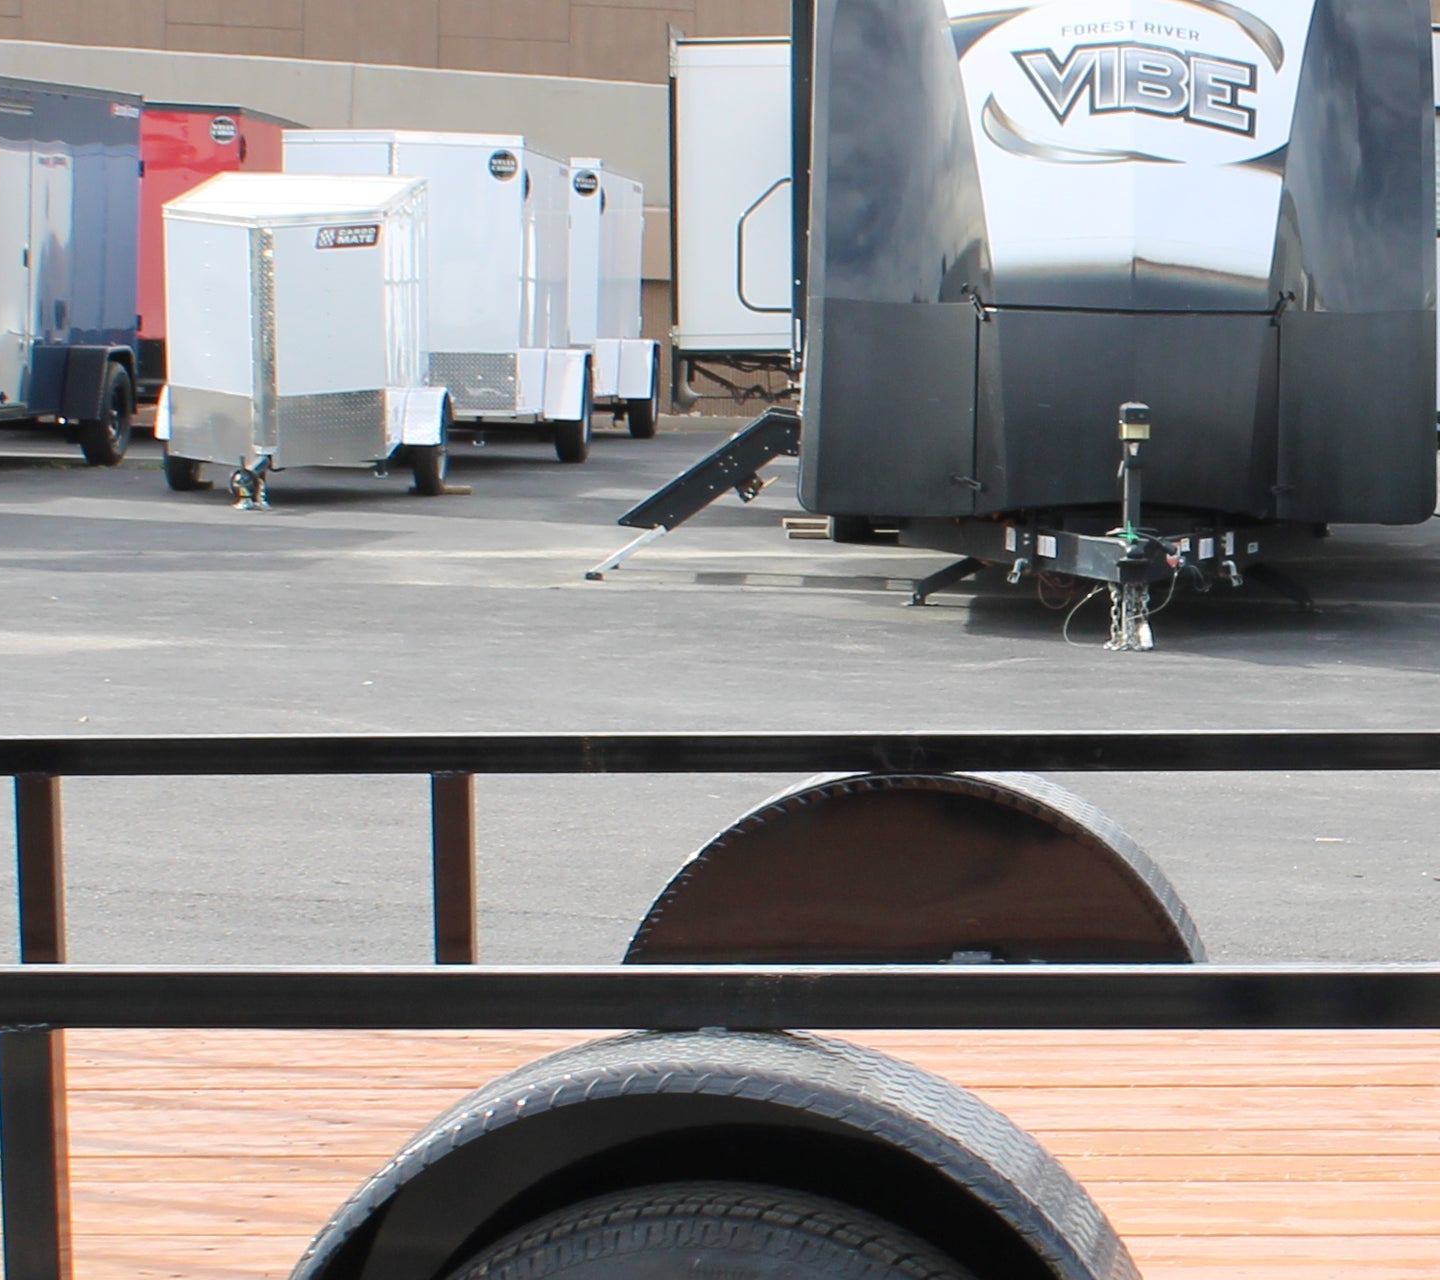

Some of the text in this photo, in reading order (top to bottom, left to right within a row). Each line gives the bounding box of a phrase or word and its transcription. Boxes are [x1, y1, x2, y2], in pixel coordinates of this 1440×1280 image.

[1061, 20, 1200, 42] FOREST RIVER
[1011, 40, 1258, 139] VIBE
[336, 234, 375, 244] MATE
